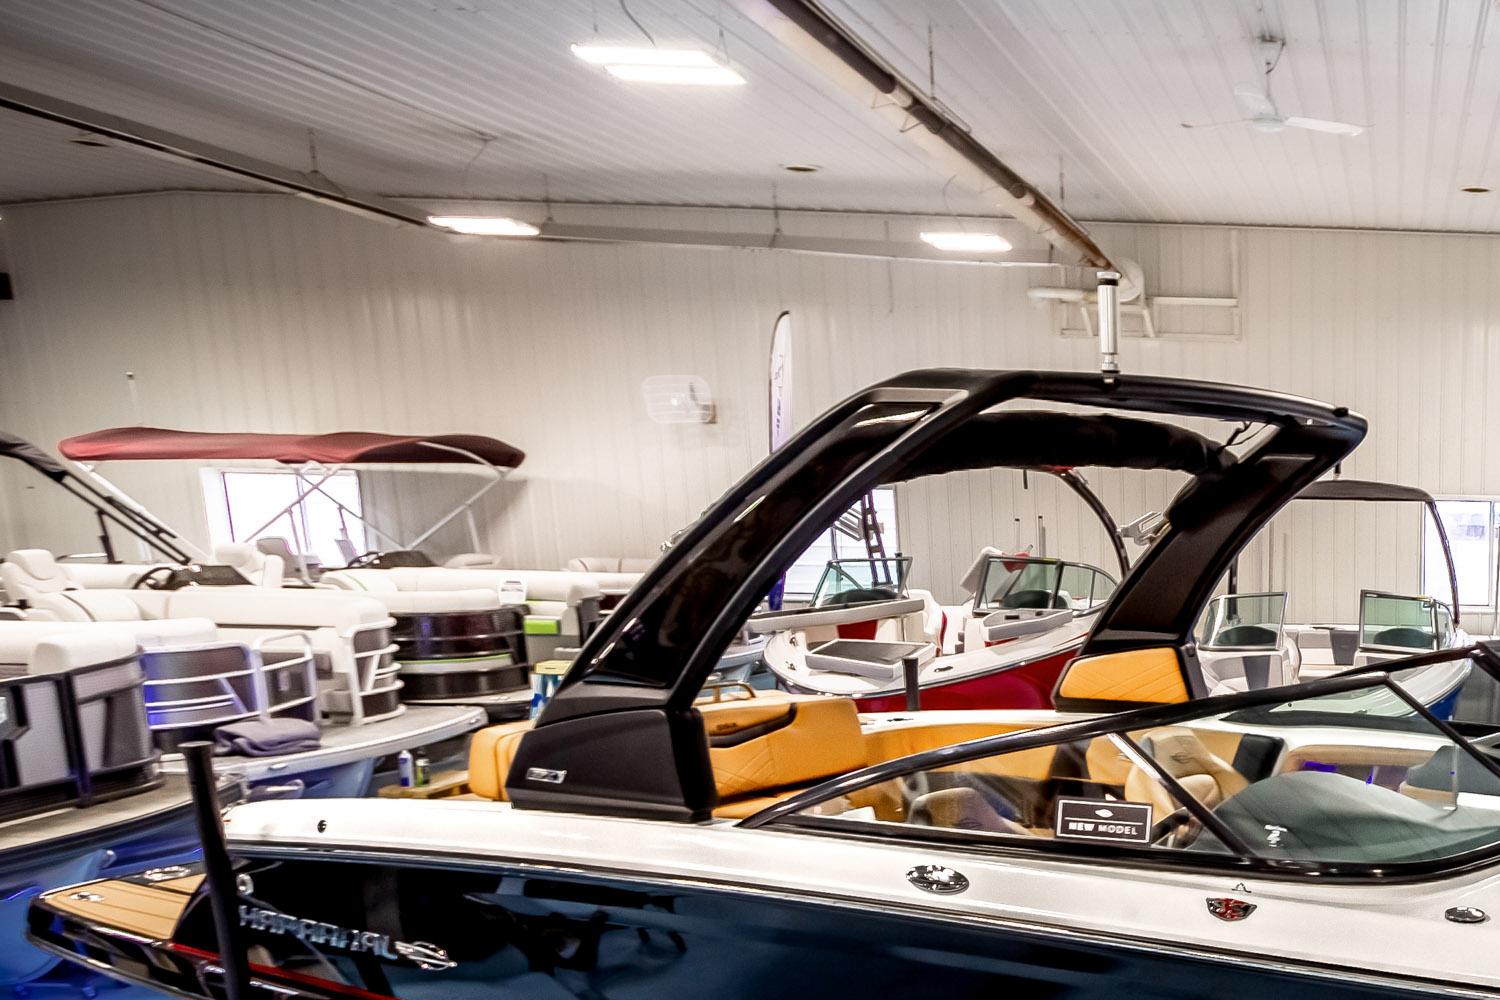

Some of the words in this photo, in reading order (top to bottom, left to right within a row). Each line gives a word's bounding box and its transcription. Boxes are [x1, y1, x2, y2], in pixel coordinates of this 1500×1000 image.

[1068, 822, 1095, 832] NEW
[1098, 825, 1138, 836] MODEL
[238, 904, 398, 961] HAPARRAL
